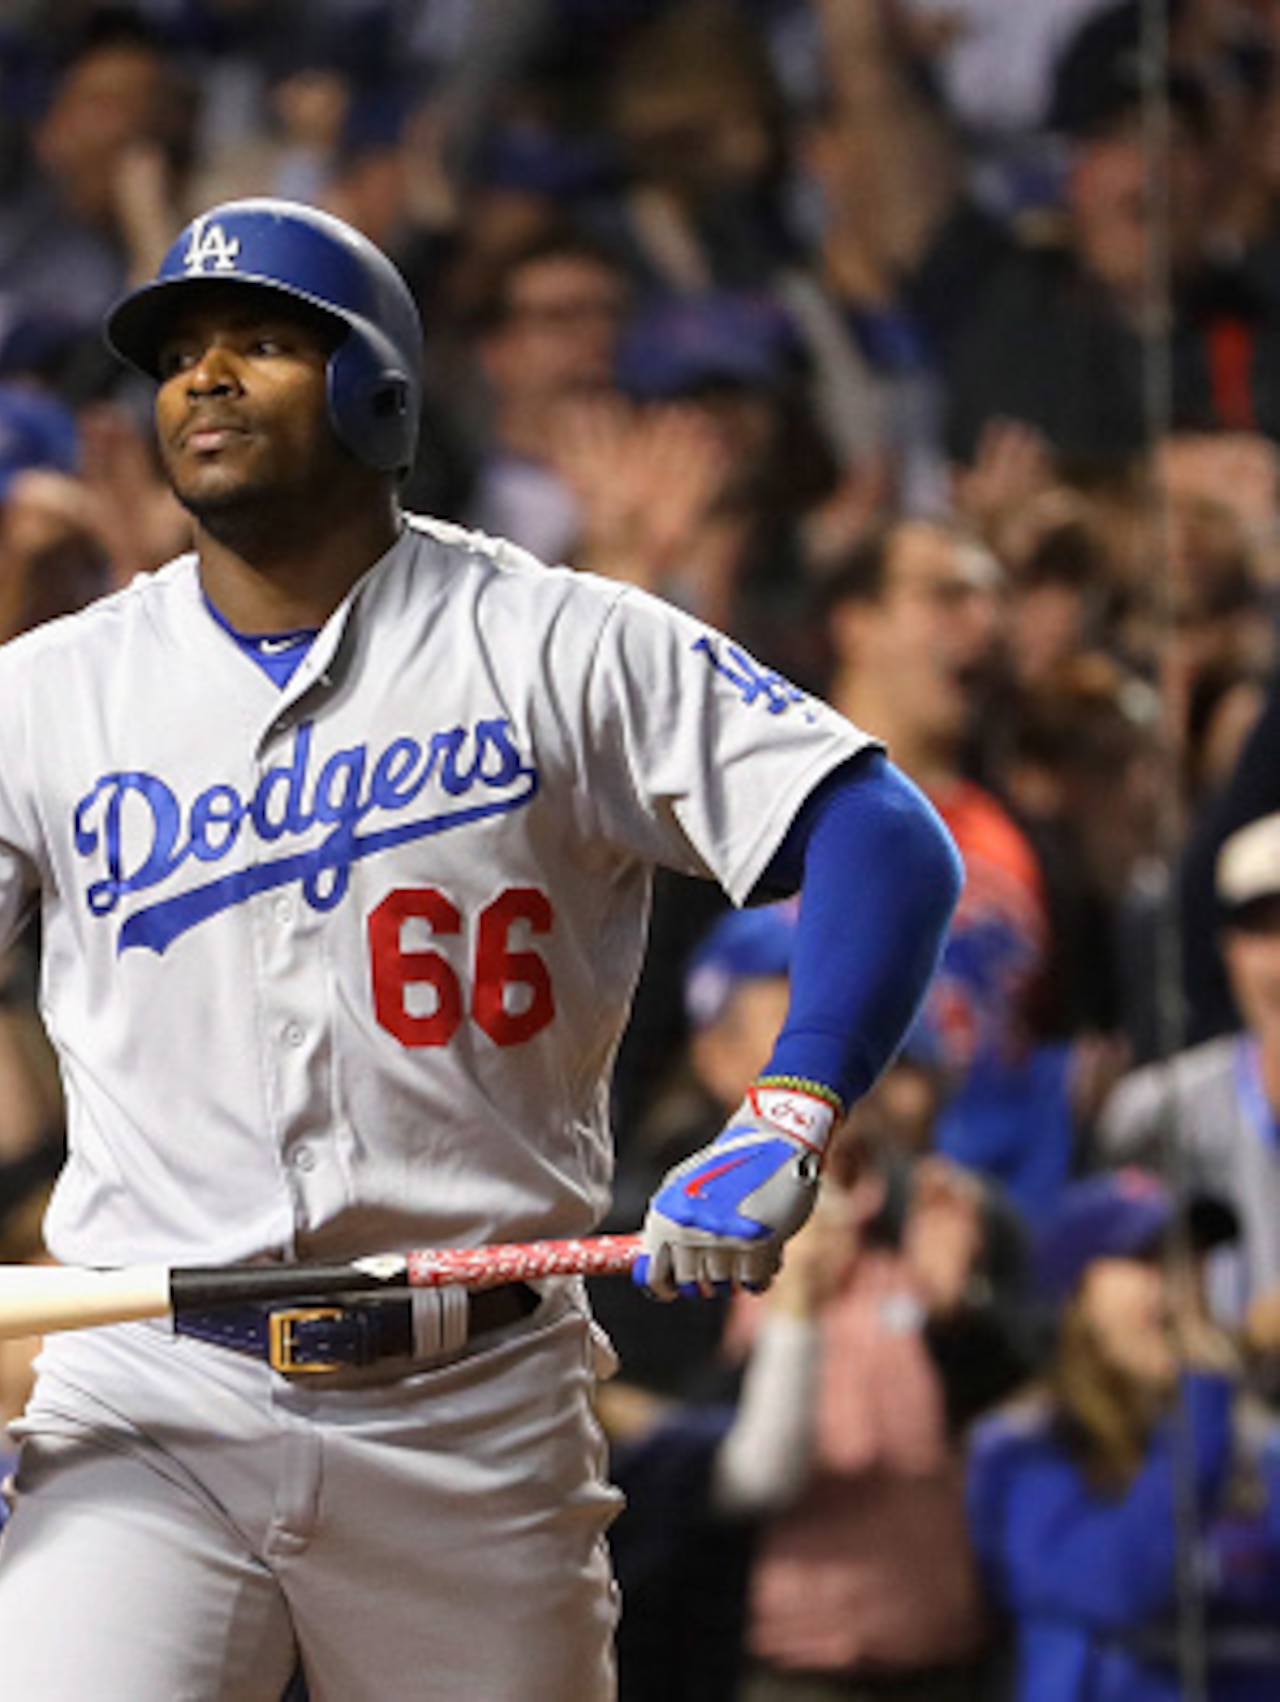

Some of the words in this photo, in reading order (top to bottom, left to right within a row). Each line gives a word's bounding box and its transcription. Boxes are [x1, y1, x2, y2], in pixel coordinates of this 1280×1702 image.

[183, 217, 240, 276] LA
[74, 719, 537, 918] Dodgers
[368, 888, 555, 1049] 66
